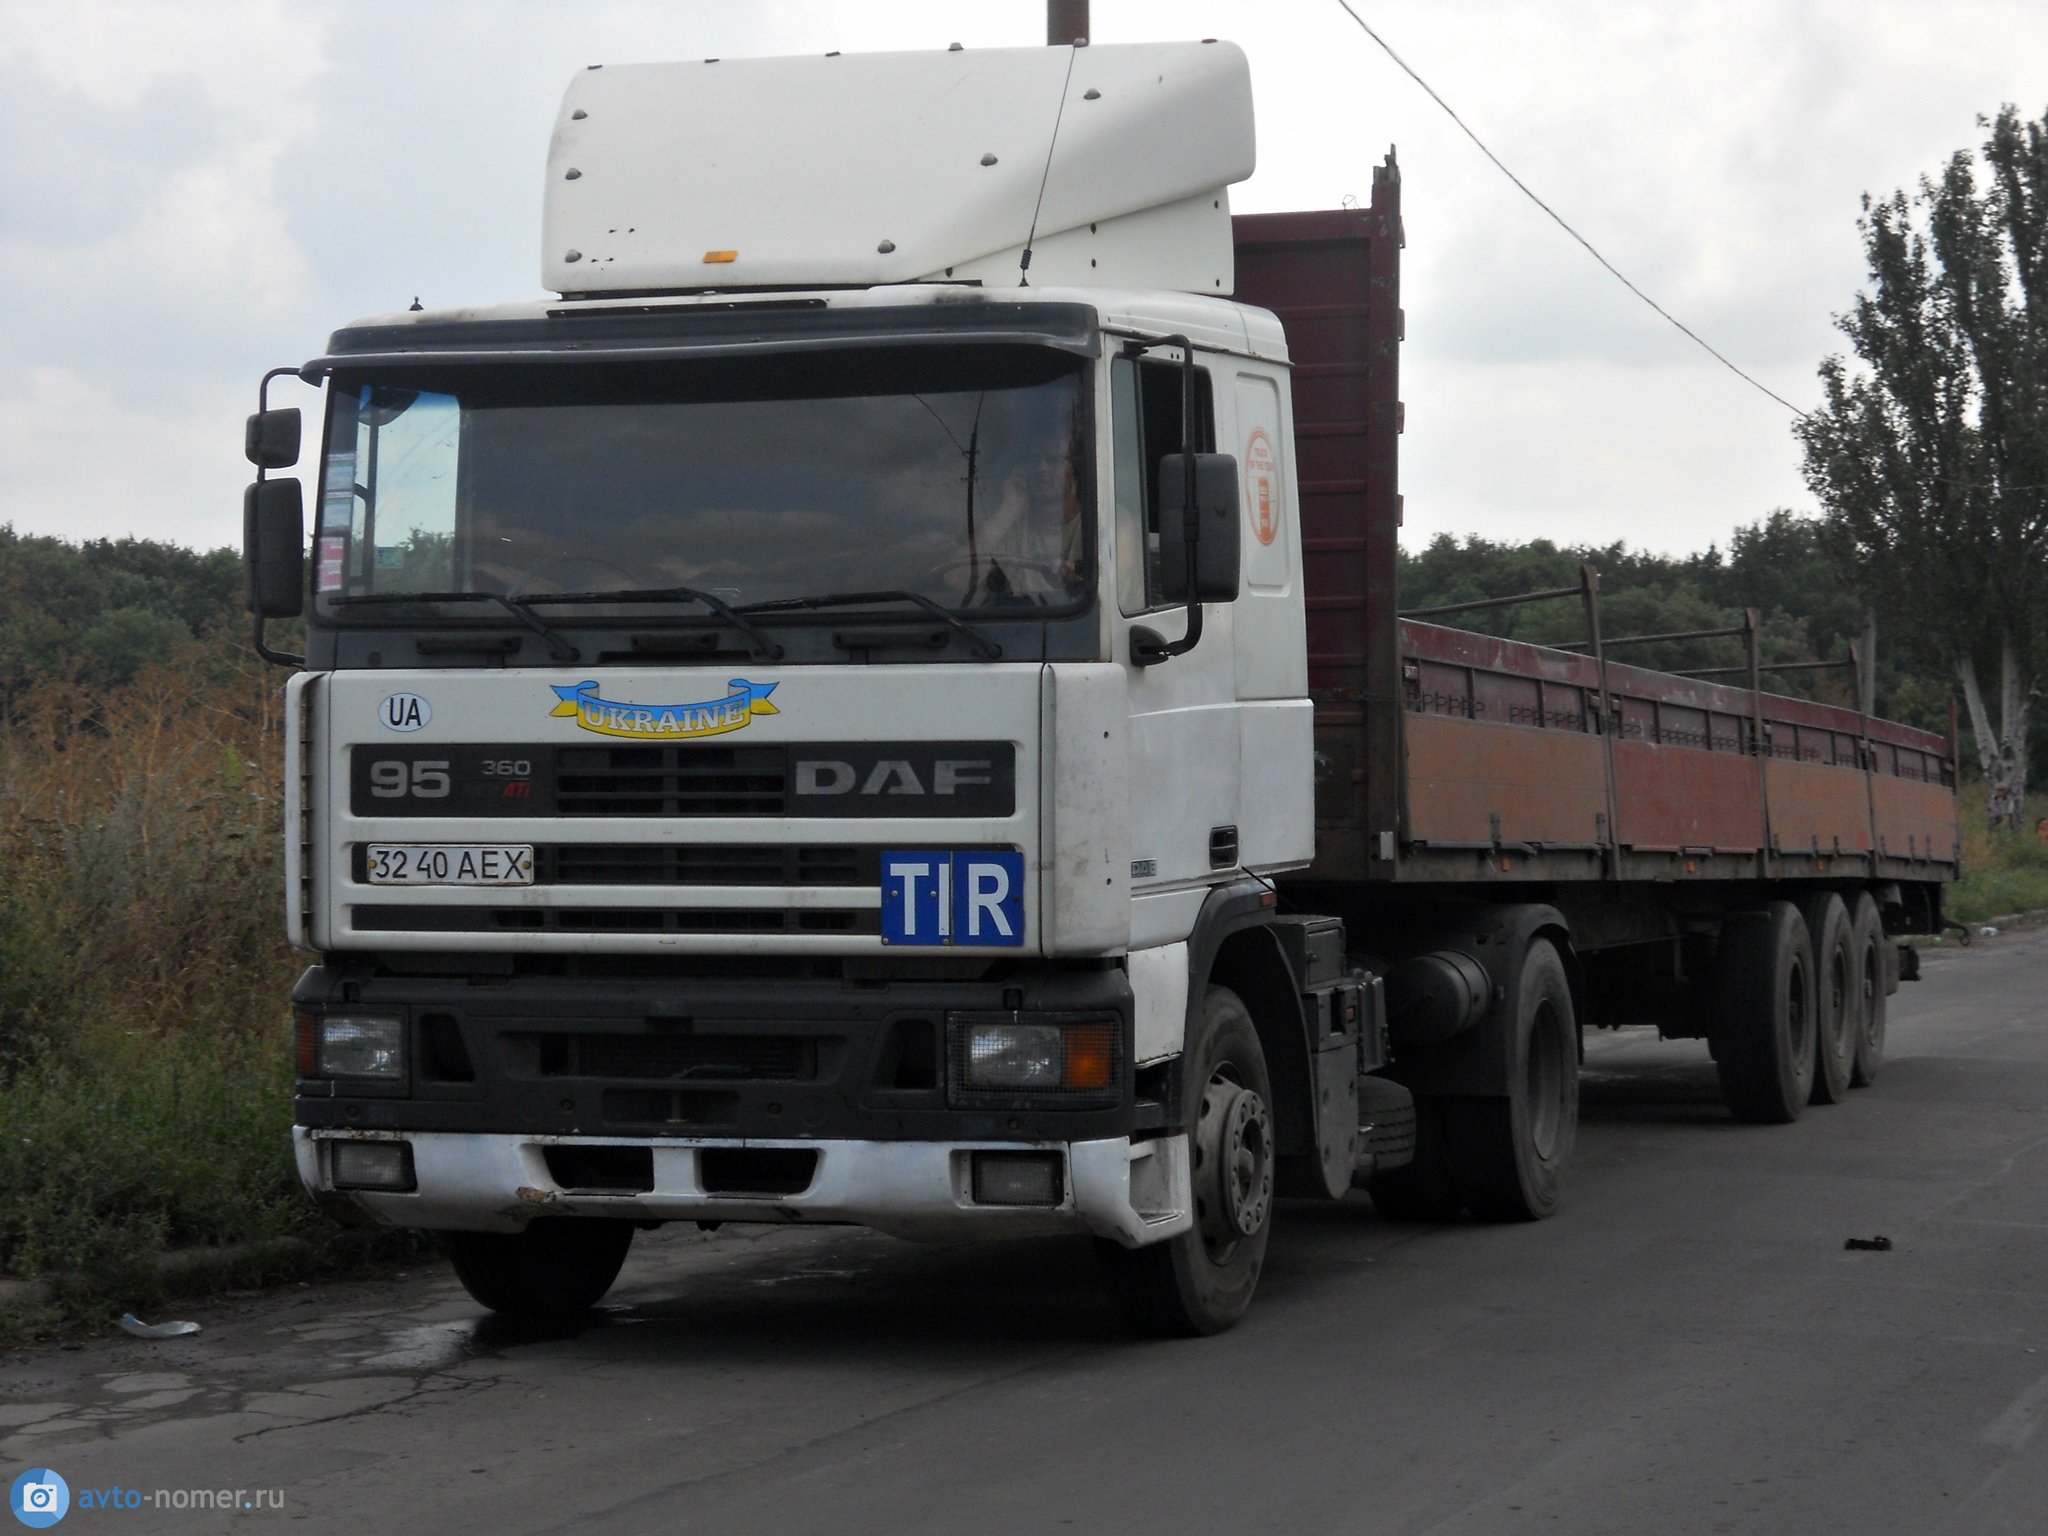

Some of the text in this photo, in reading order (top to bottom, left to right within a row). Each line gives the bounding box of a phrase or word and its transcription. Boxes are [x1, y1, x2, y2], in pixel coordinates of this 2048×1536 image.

[390, 698, 422, 727] UA
[583, 698, 745, 733] UKRAINE
[371, 760, 451, 798] 95
[481, 760, 531, 776] 360
[795, 760, 992, 795] DAF
[457, 850, 525, 879] AEX
[890, 863, 1013, 936] TIR
